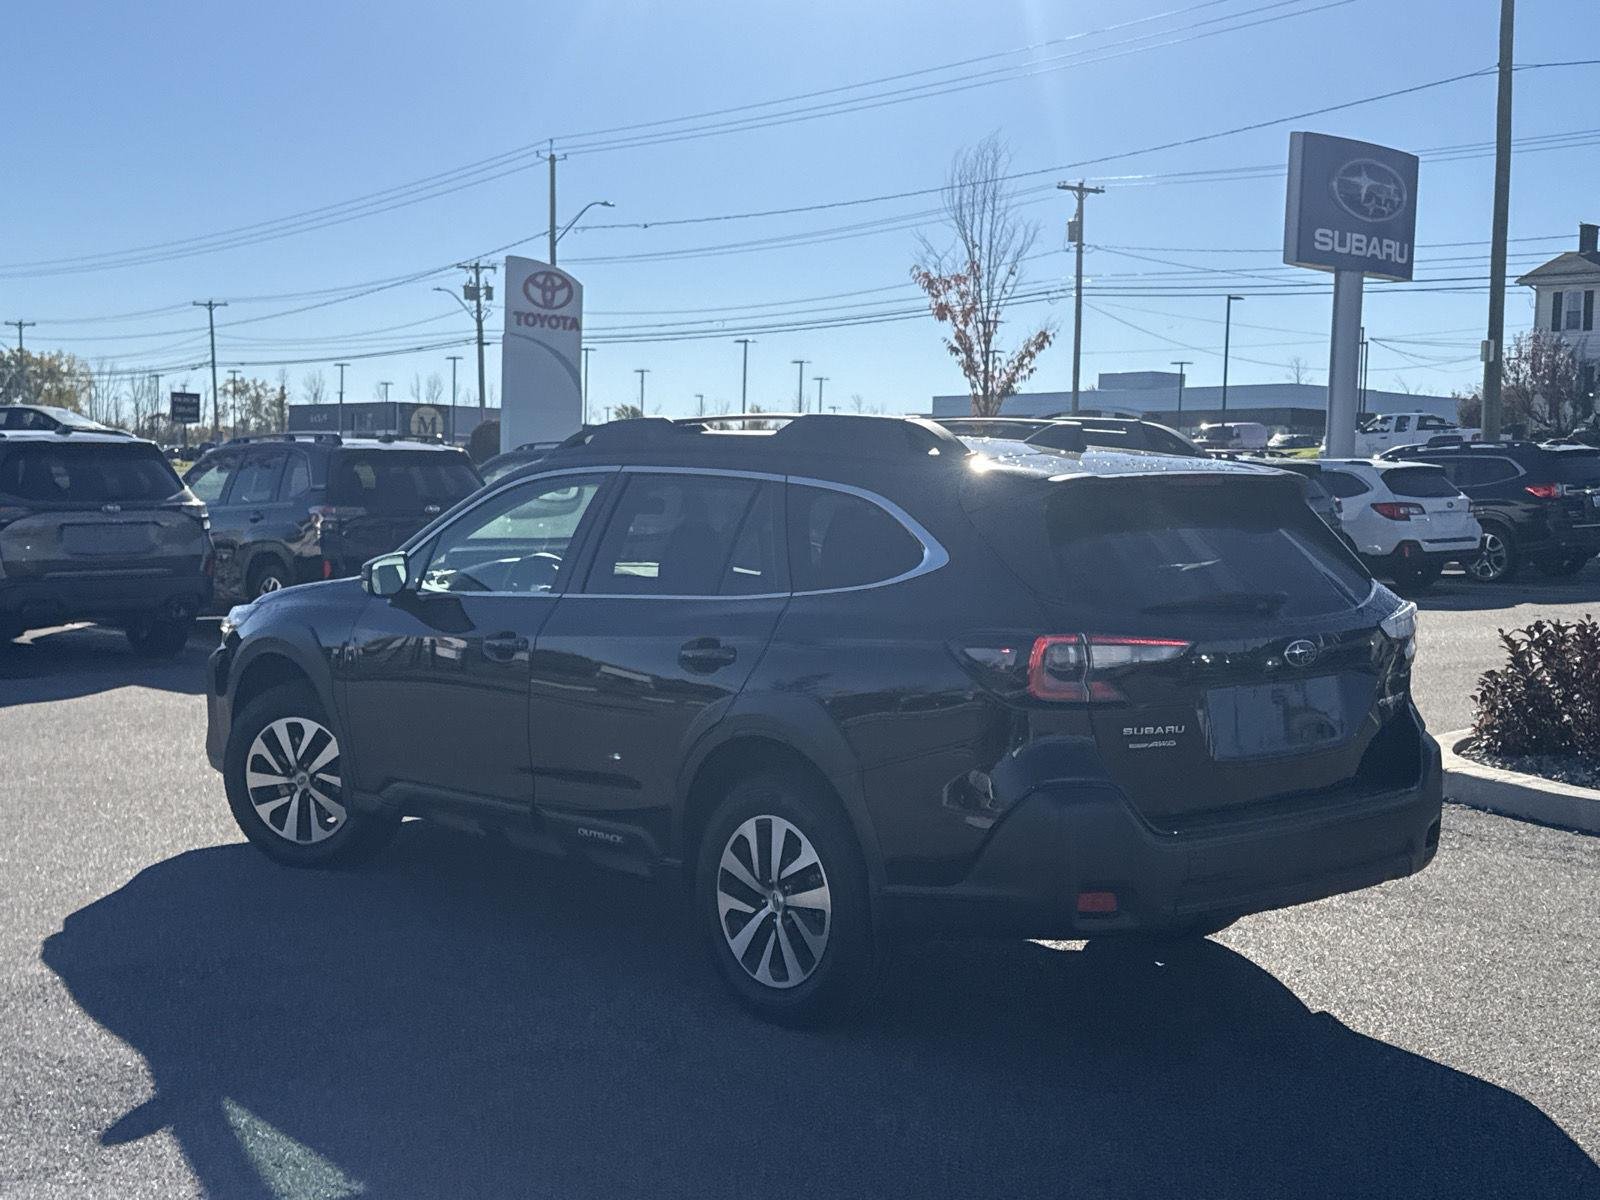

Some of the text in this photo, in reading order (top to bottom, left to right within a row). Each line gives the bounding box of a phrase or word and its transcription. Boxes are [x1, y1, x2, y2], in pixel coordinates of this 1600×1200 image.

[1313, 228, 1409, 264] SUBARU
[513, 310, 580, 331] TOYOTA
[1122, 725, 1185, 735] SUBARU
